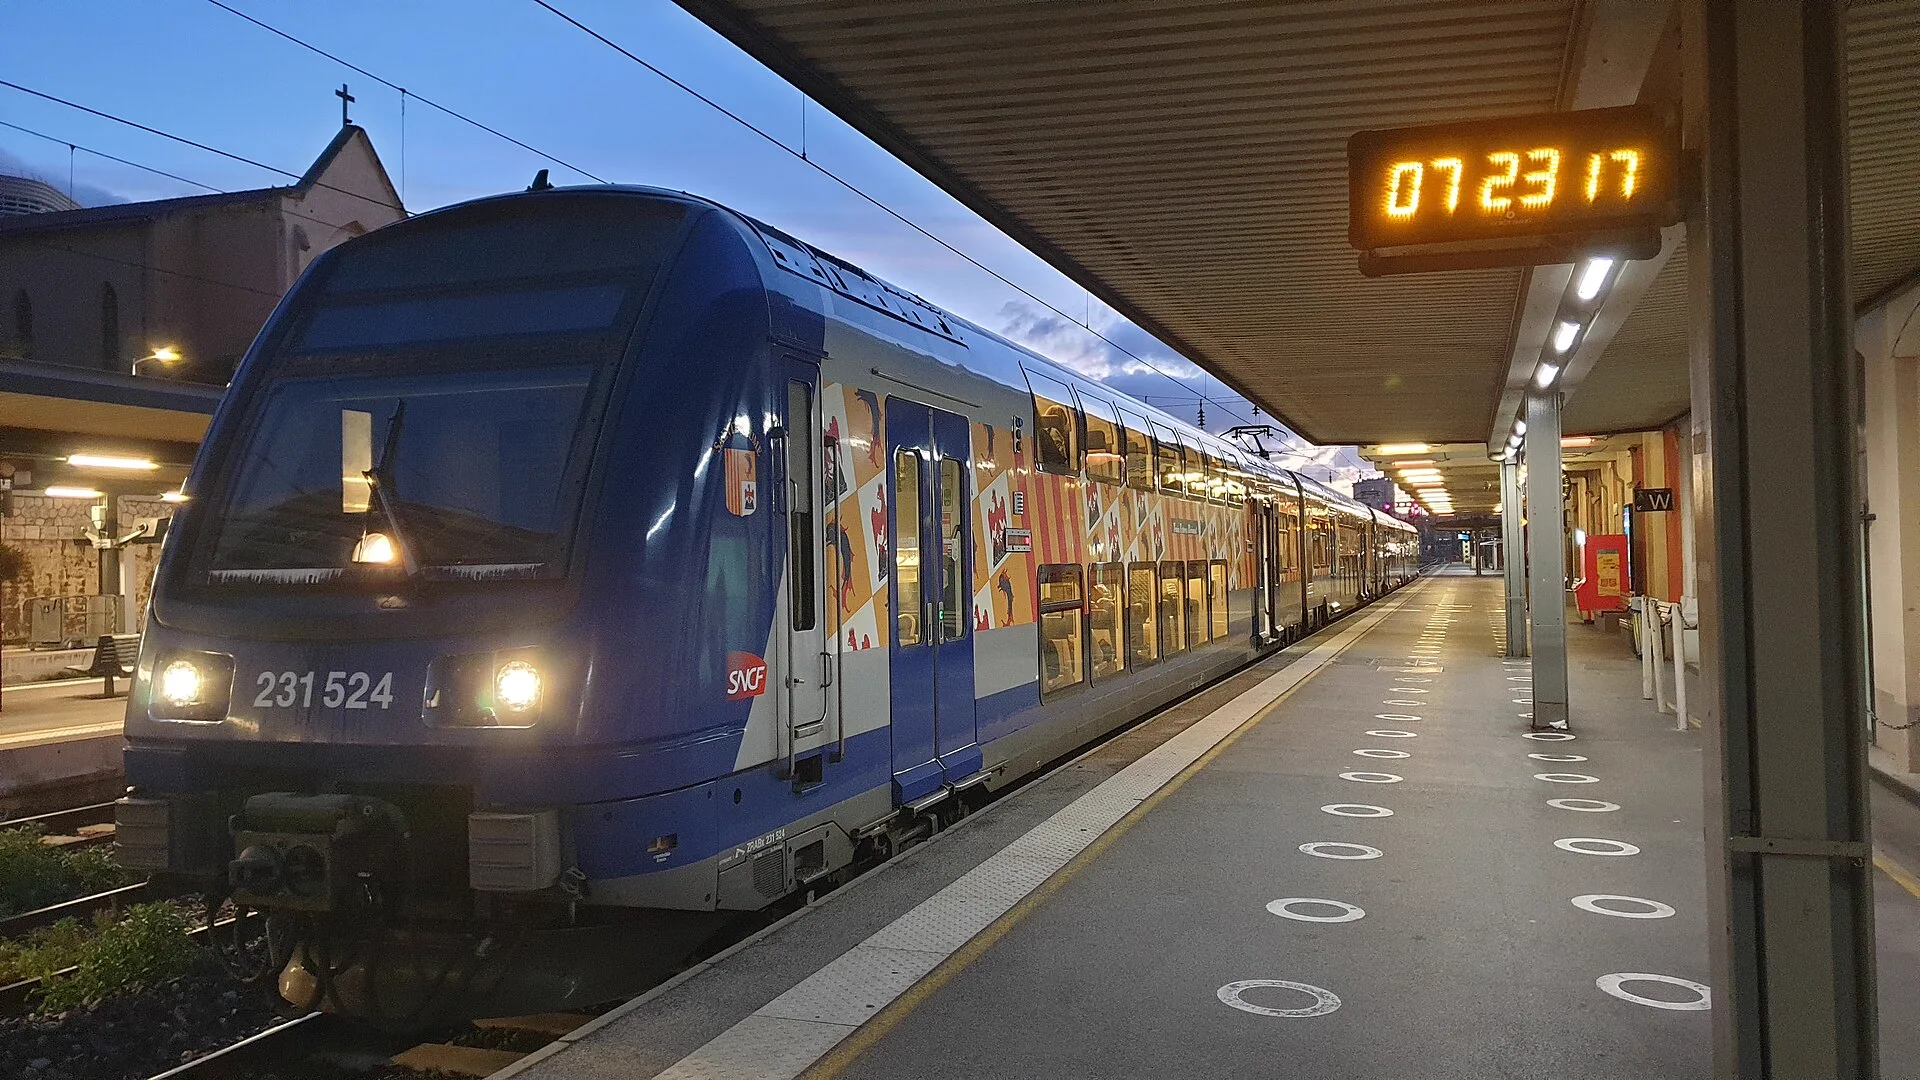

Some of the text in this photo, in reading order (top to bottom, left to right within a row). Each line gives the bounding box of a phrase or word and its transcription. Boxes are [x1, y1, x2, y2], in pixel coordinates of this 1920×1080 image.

[1382, 149, 1641, 217] 07 23 17
[1649, 493, 1671, 510] W
[253, 671, 394, 710] 231 524
[727, 666, 766, 695] SNCF
[766, 833, 775, 845] 231
[775, 828, 785, 840] 524
